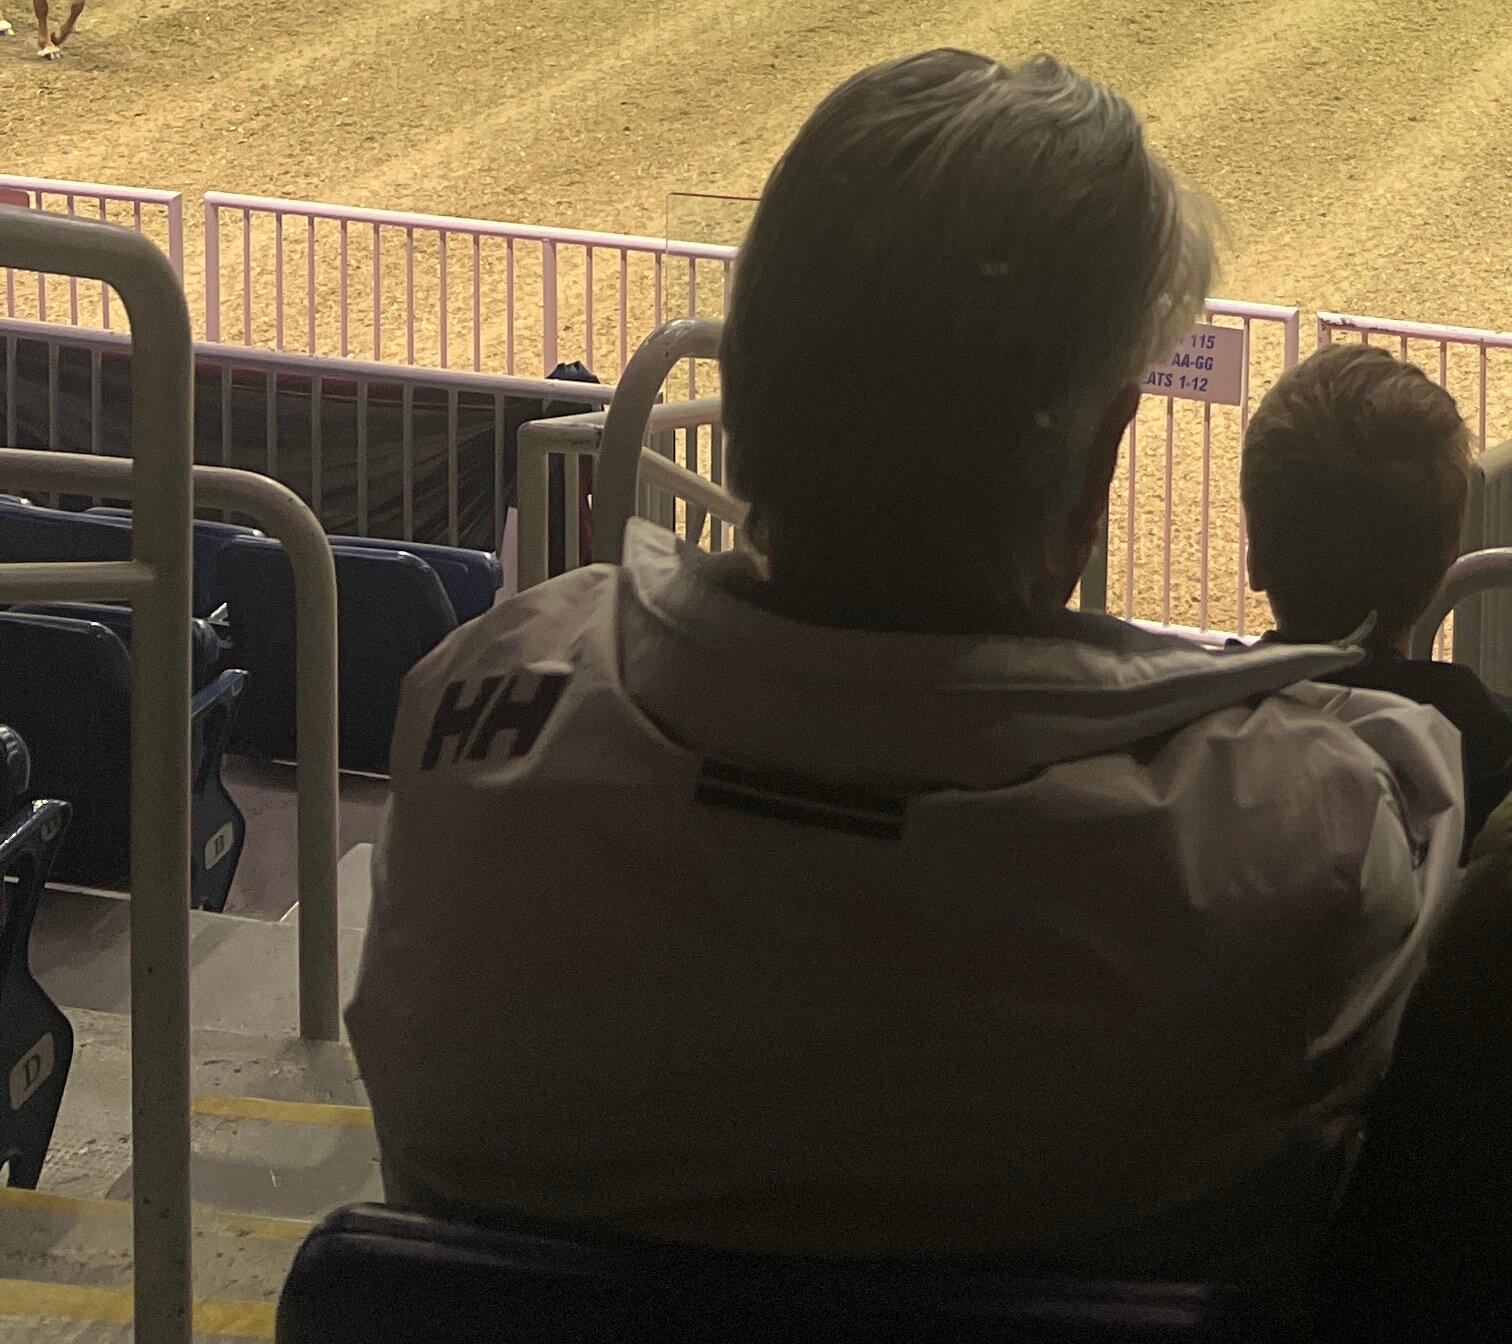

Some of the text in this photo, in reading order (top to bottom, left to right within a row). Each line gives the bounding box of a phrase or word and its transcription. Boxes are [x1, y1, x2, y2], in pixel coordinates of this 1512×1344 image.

[1171, 352, 1214, 371] AA-GG
[1179, 375, 1208, 392] 1-12
[421, 671, 572, 770] HH
